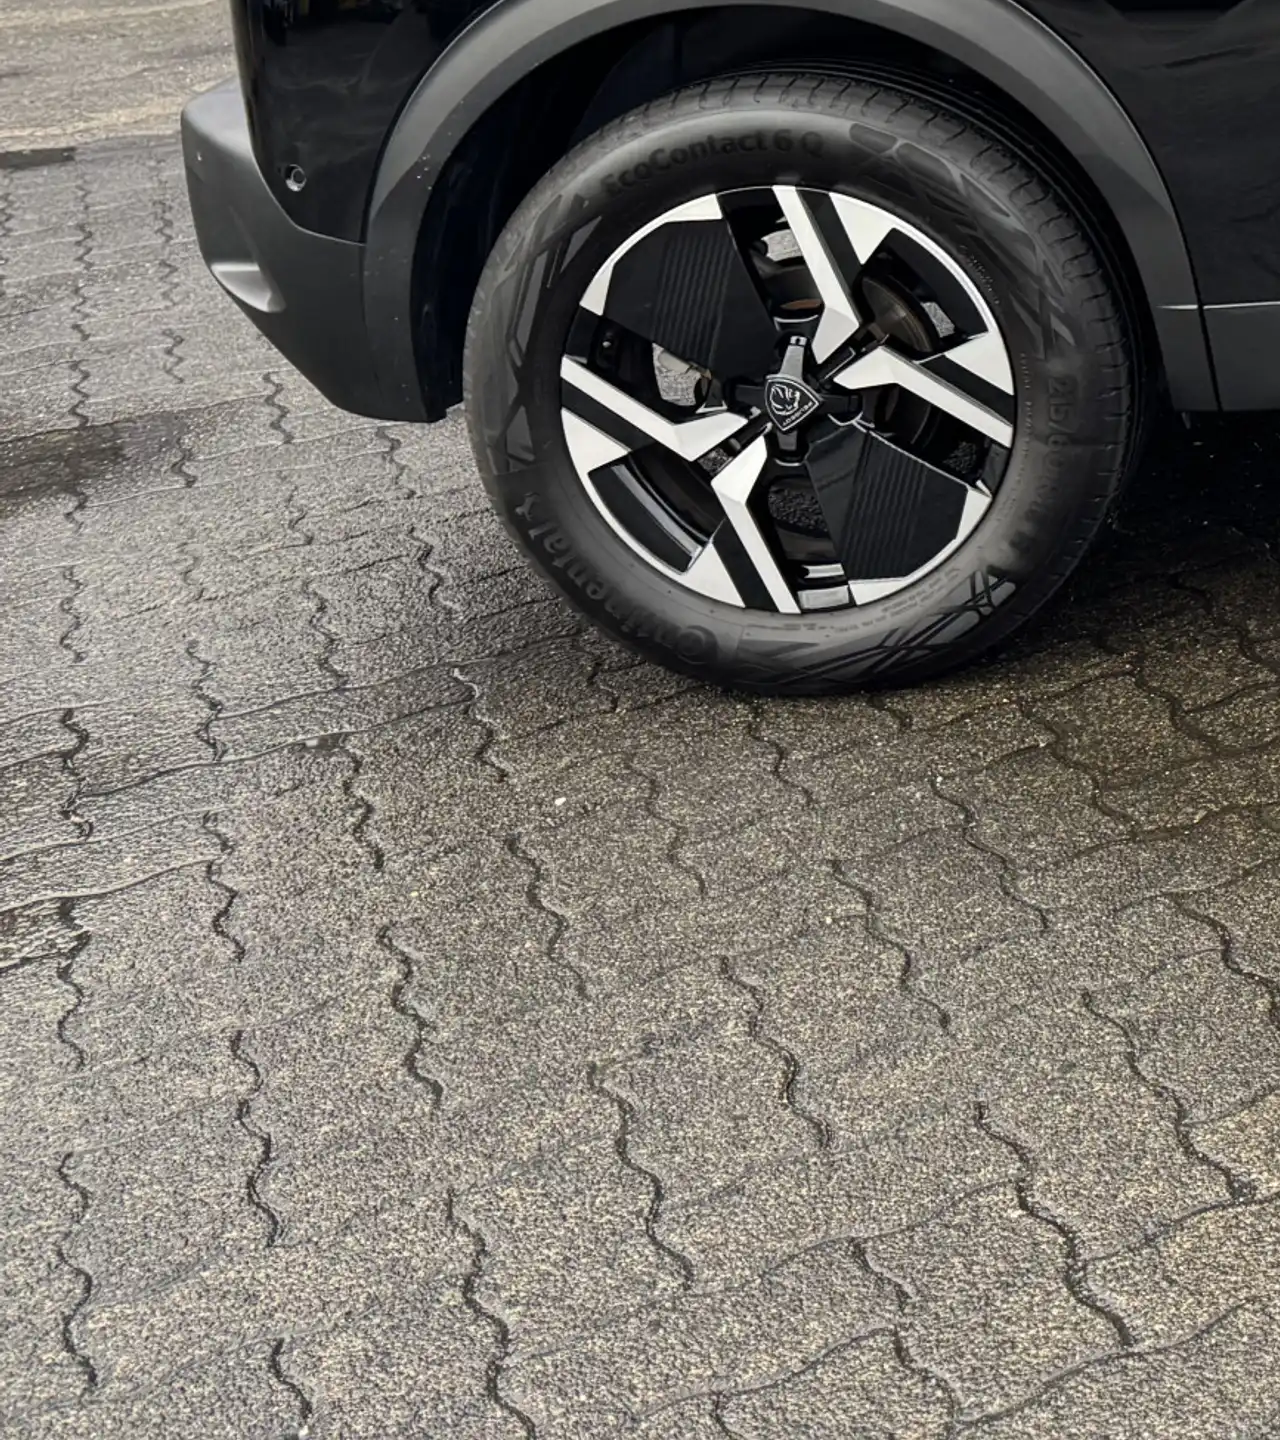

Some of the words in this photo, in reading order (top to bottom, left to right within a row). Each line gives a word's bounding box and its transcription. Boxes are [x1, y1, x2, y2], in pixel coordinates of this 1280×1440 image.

[601, 130, 769, 197] EcoContact
[771, 128, 795, 153] 6
[801, 130, 825, 159] Q
